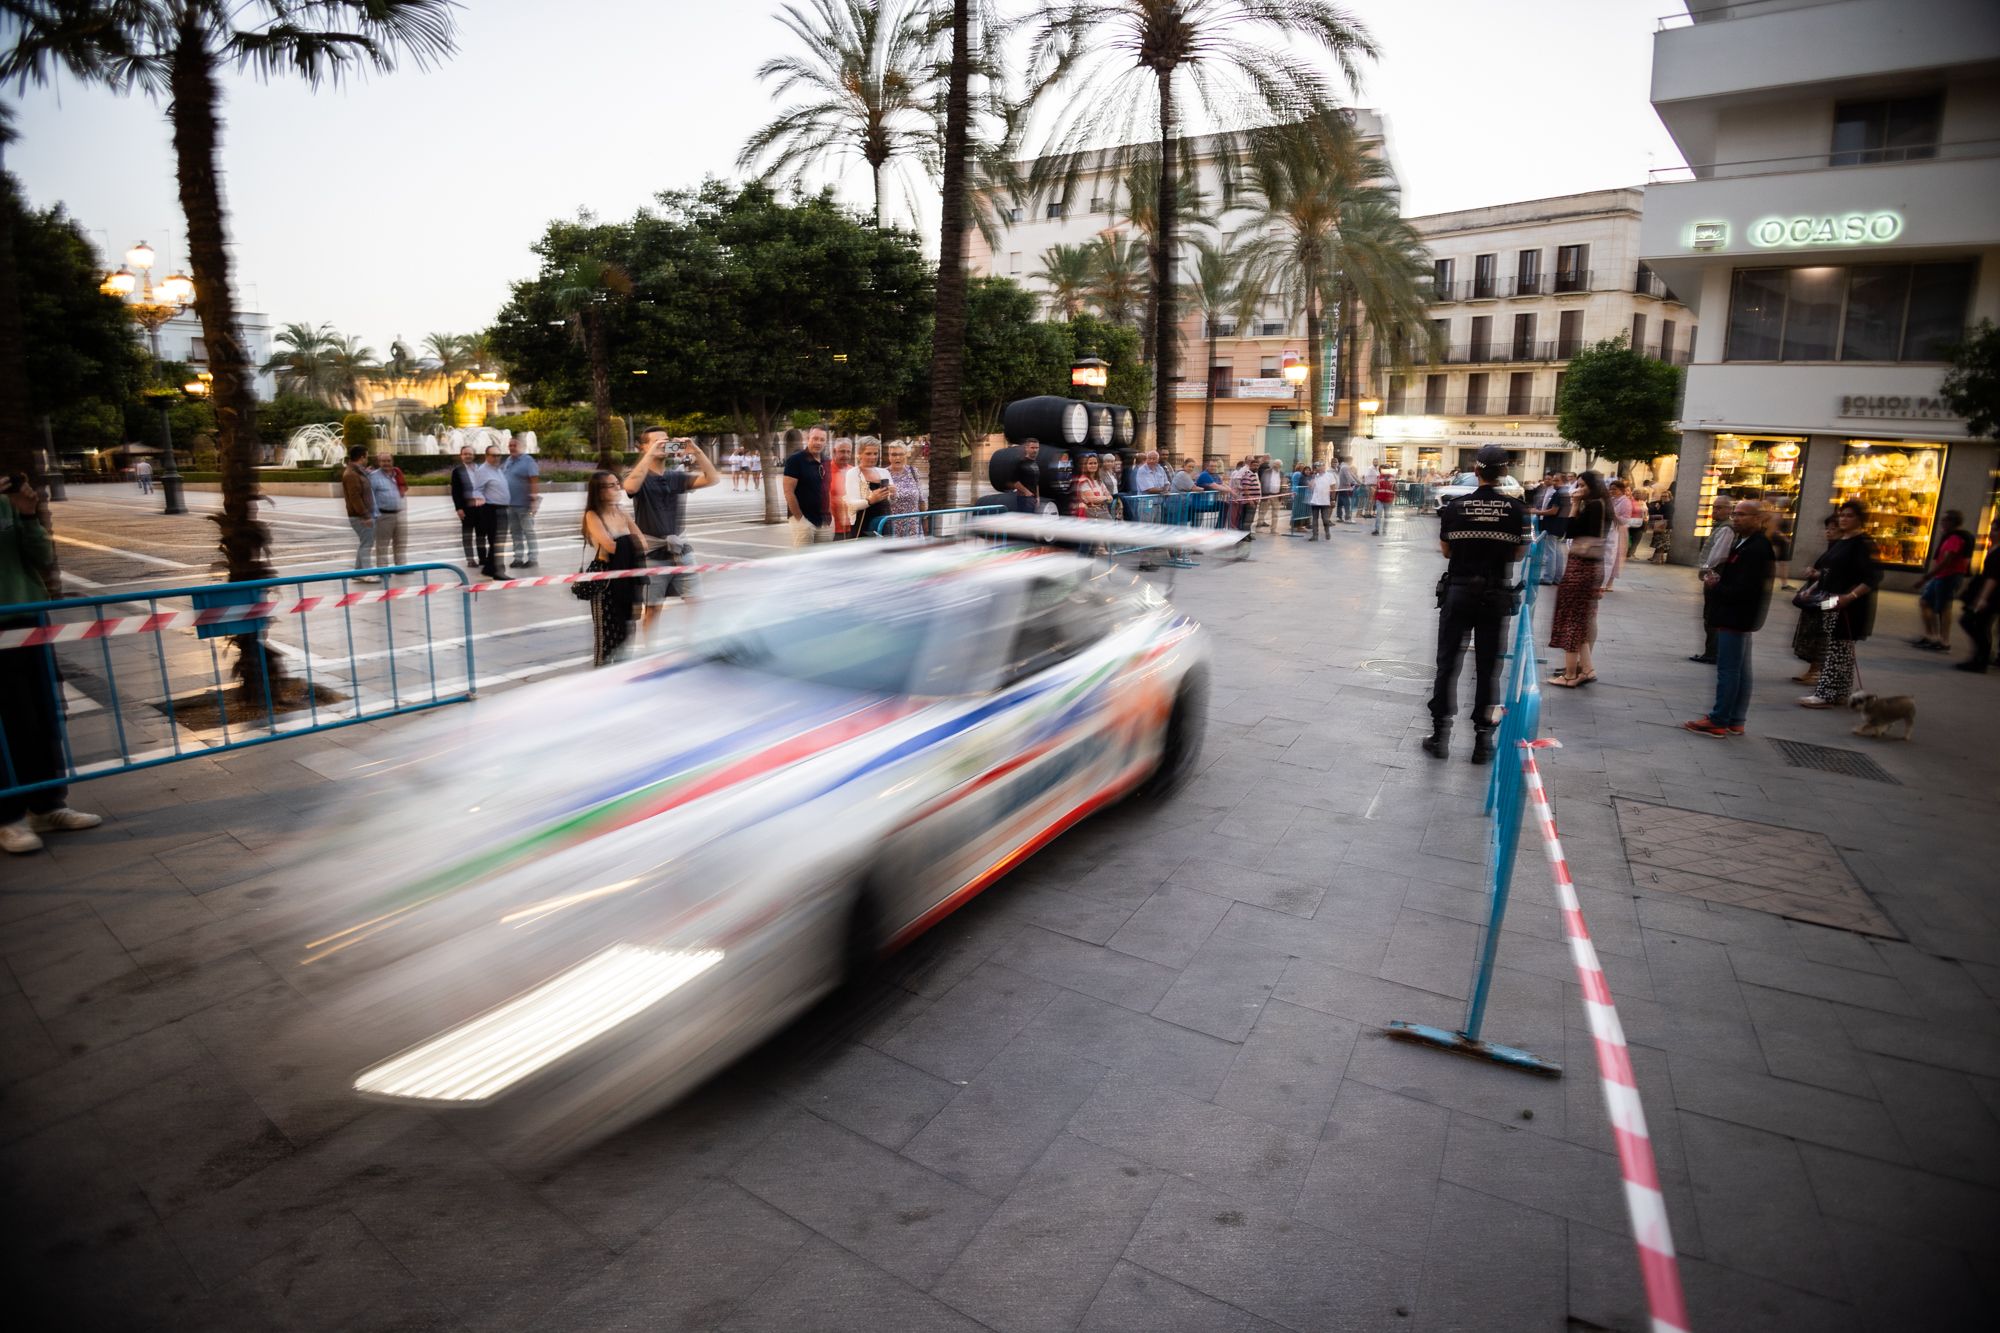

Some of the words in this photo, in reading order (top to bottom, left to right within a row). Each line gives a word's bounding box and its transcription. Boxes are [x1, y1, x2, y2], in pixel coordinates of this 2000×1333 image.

[1757, 213, 1900, 245] OCASO
[1327, 355, 1337, 413] PALESTINA
[1840, 396, 1911, 410] BOLSOS
[1463, 500, 1512, 508] POLICIA
[1465, 508, 1509, 516] LOCAL
